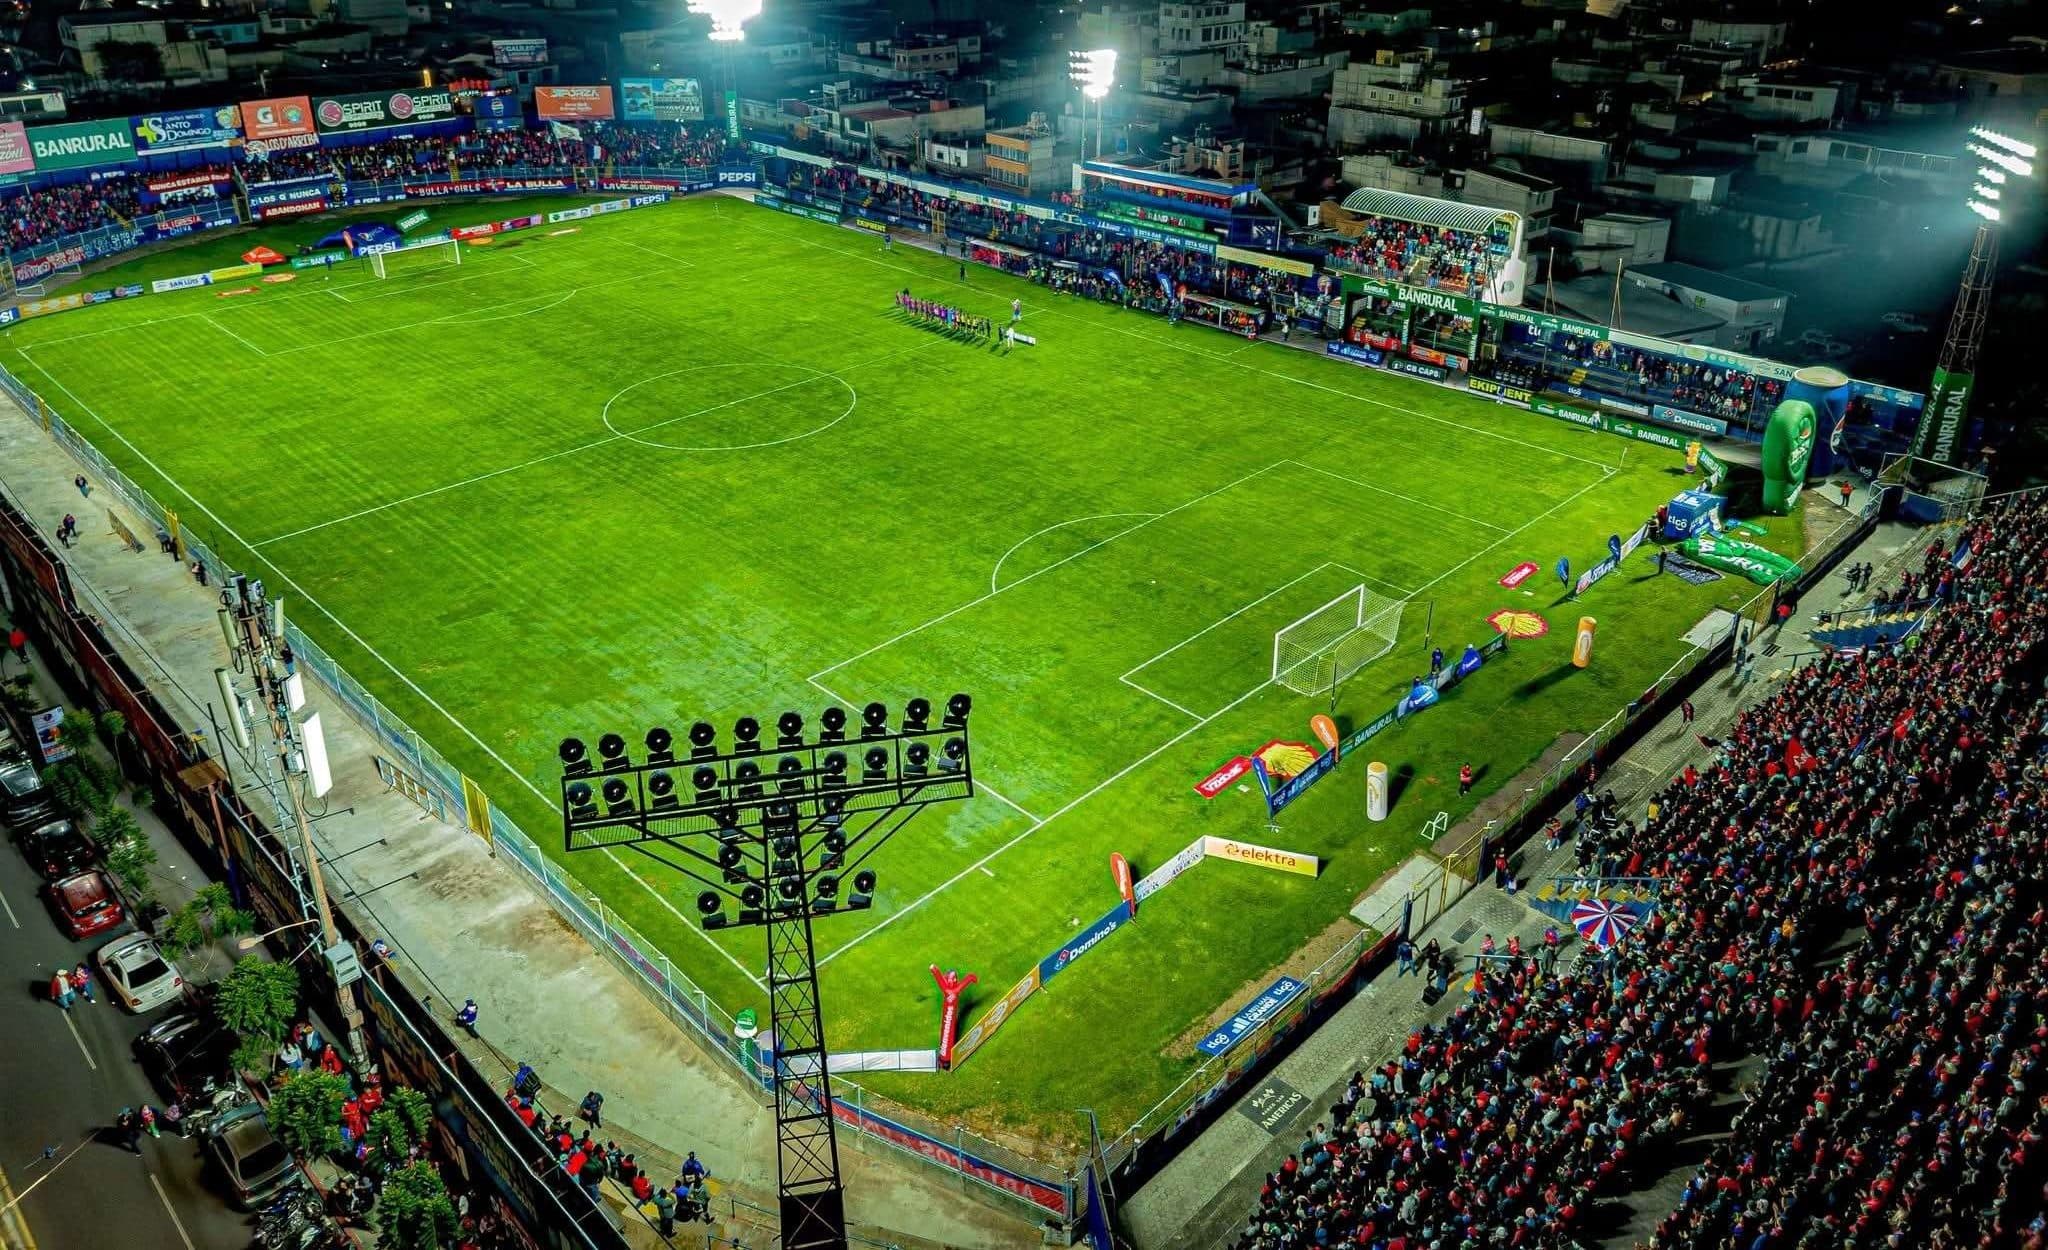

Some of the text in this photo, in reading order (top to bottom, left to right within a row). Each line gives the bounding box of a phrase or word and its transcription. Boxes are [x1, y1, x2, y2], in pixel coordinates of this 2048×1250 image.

[342, 101, 382, 116] SPIRIT
[411, 94, 449, 107] SPIRIT
[167, 128, 212, 141] DOMINGO
[34, 132, 130, 158] BANRURAL
[718, 172, 756, 182] PEPSI
[258, 195, 276, 204] LOS
[289, 188, 321, 200] NUNCA
[419, 185, 449, 197] BULLA
[636, 194, 665, 206] PEPSI
[265, 201, 321, 216] ABANDONAN
[359, 242, 396, 256] PEPSI
[1398, 288, 1458, 312] BANRURAL
[1499, 309, 1535, 324] BANRURAL
[1561, 322, 1601, 339] BANRURAL
[1774, 367, 1793, 378] SAN
[1558, 409, 1594, 425] BANRURA
[1673, 416, 1717, 433] Domino's
[1931, 386, 1968, 462] BANRURAL
[1637, 430, 1680, 448] BANRURAL
[1668, 515, 1688, 531] tigo
[1355, 713, 1393, 745] BANRURAL
[1241, 847, 1297, 868] elektra
[1069, 920, 1117, 962] Domino's
[1275, 980, 1295, 996] tigo
[1206, 1032, 1229, 1049] tigo
[1261, 1091, 1302, 1130] AMERICAS
